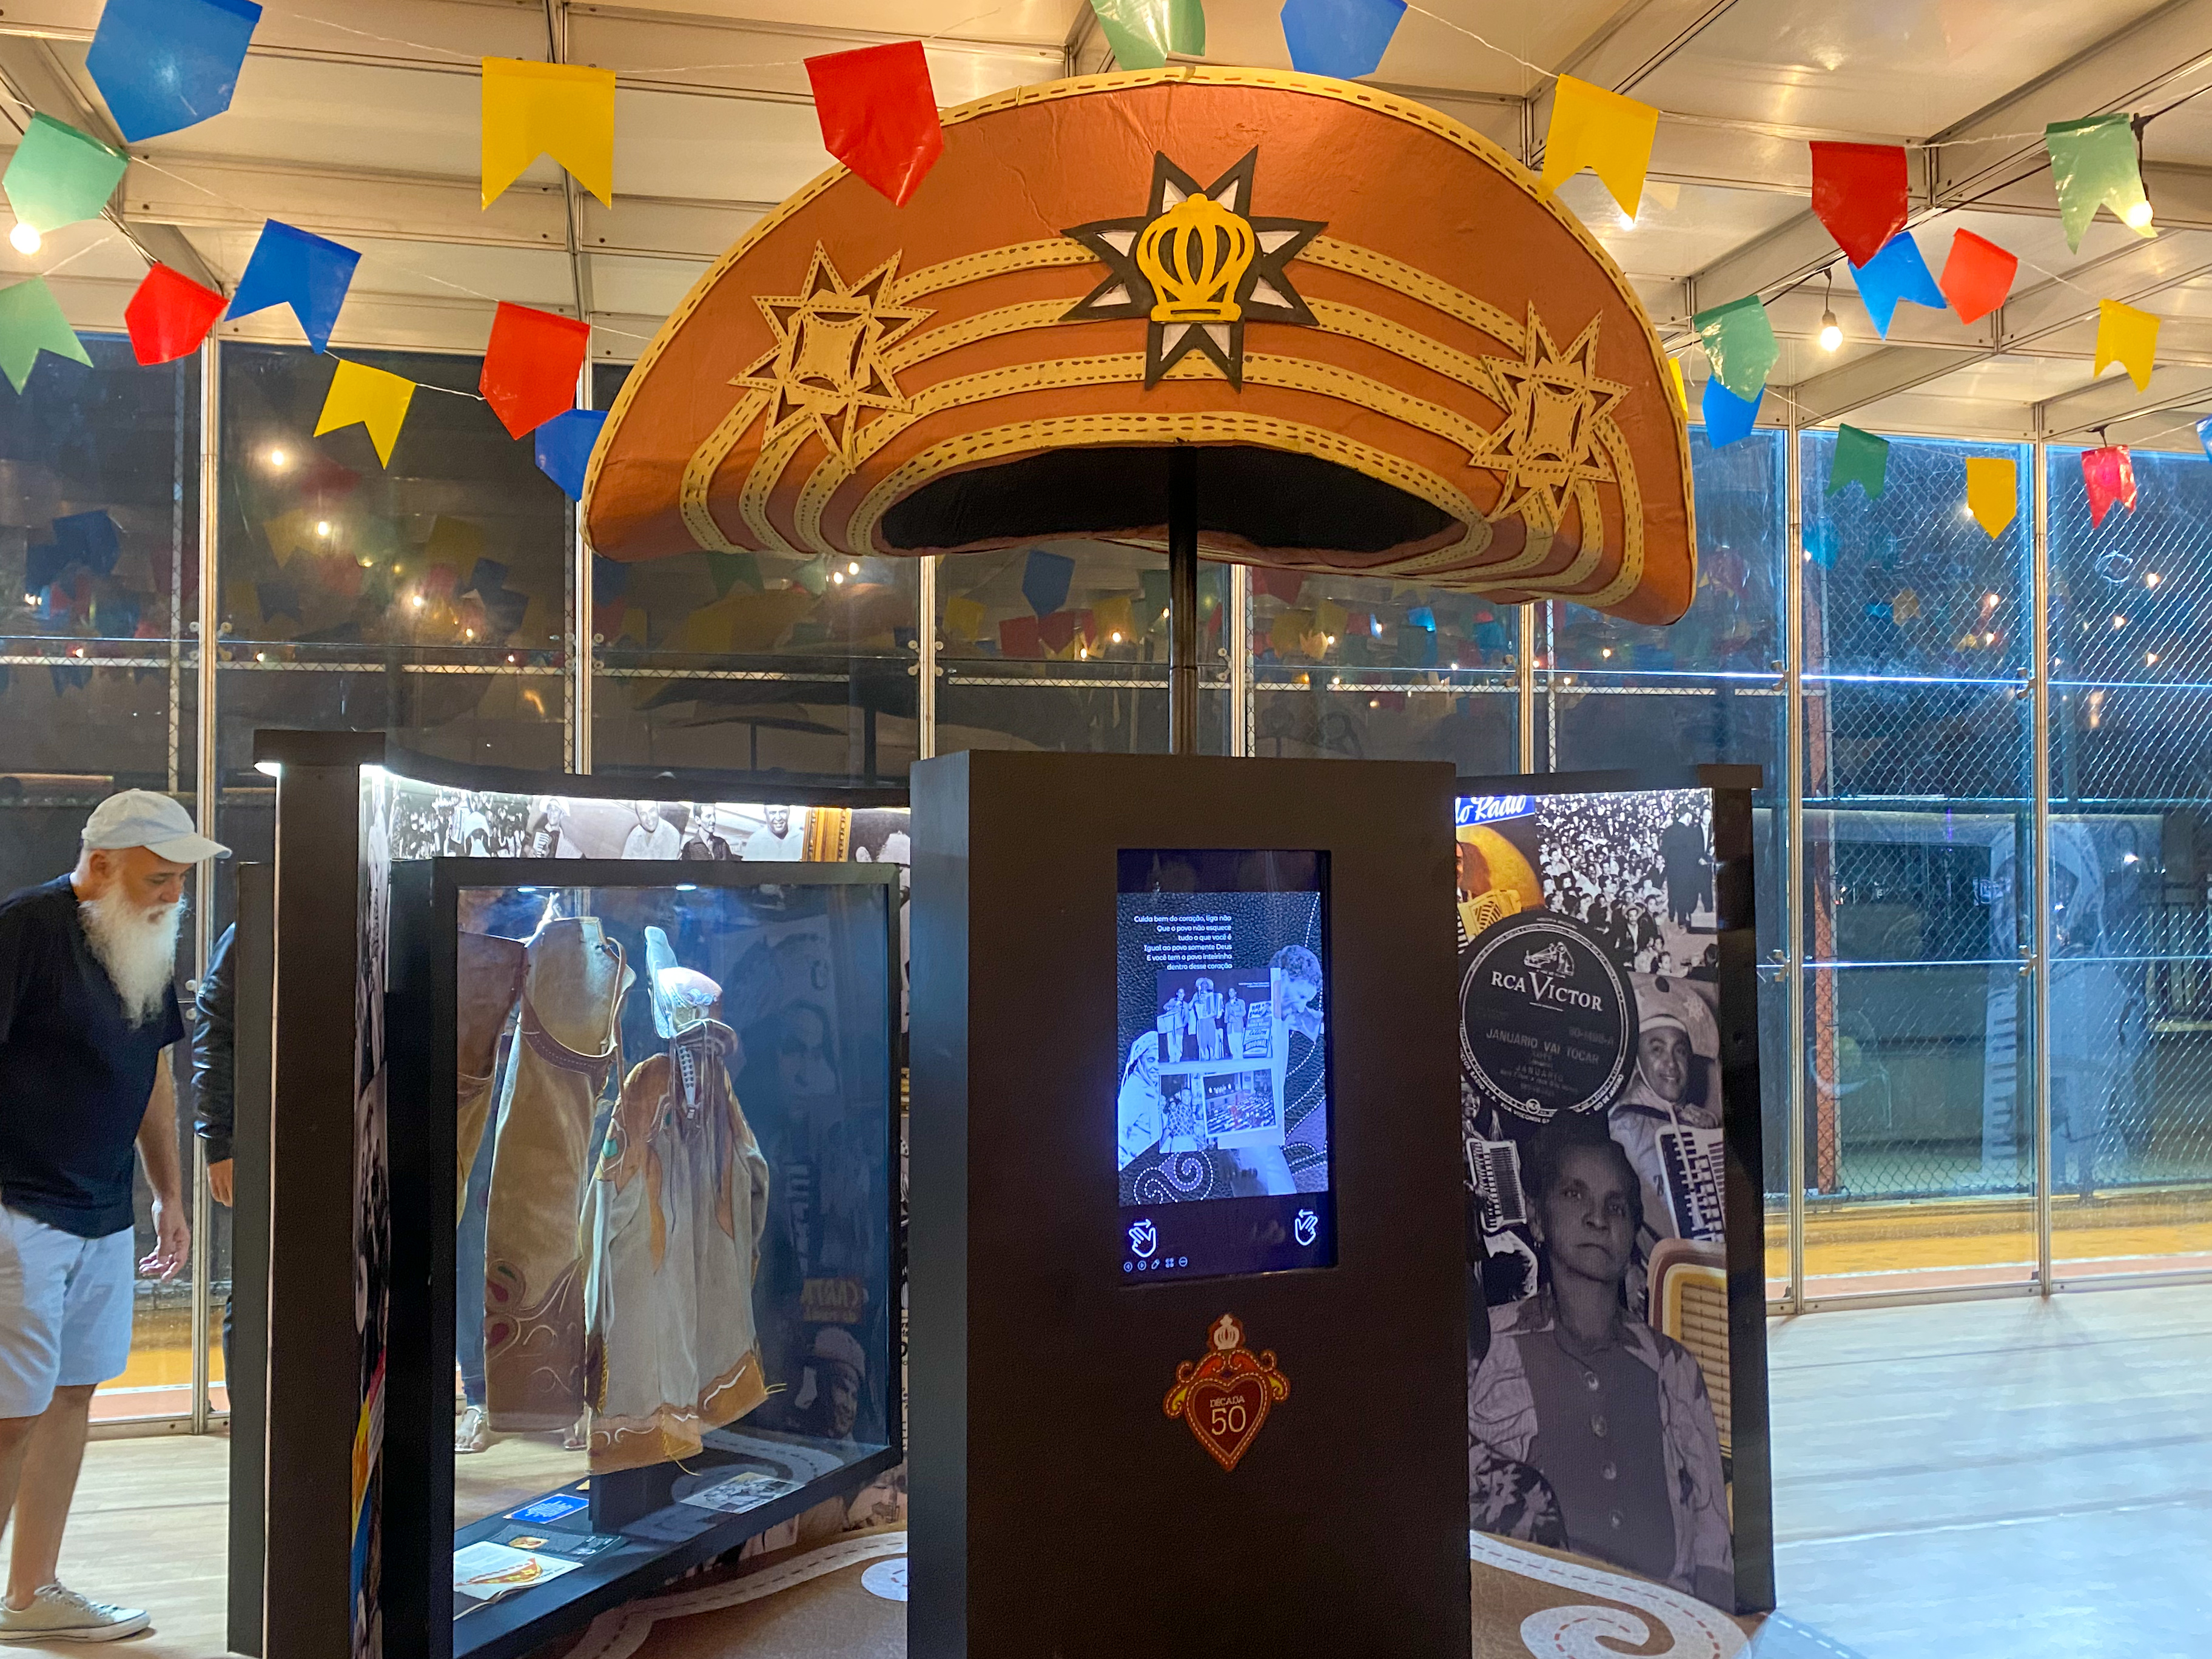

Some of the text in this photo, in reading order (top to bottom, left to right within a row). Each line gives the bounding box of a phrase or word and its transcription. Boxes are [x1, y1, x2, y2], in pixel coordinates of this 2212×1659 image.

[1206, 914, 1219, 923] liga
[1490, 971, 1603, 1011] RCA VICTOR
[1486, 1029, 1538, 1049] JANUARIO
[1543, 1041, 1561, 1055] VAI
[1566, 1045, 1599, 1064] TOCAR
[1211, 1405, 1246, 1435] 50
